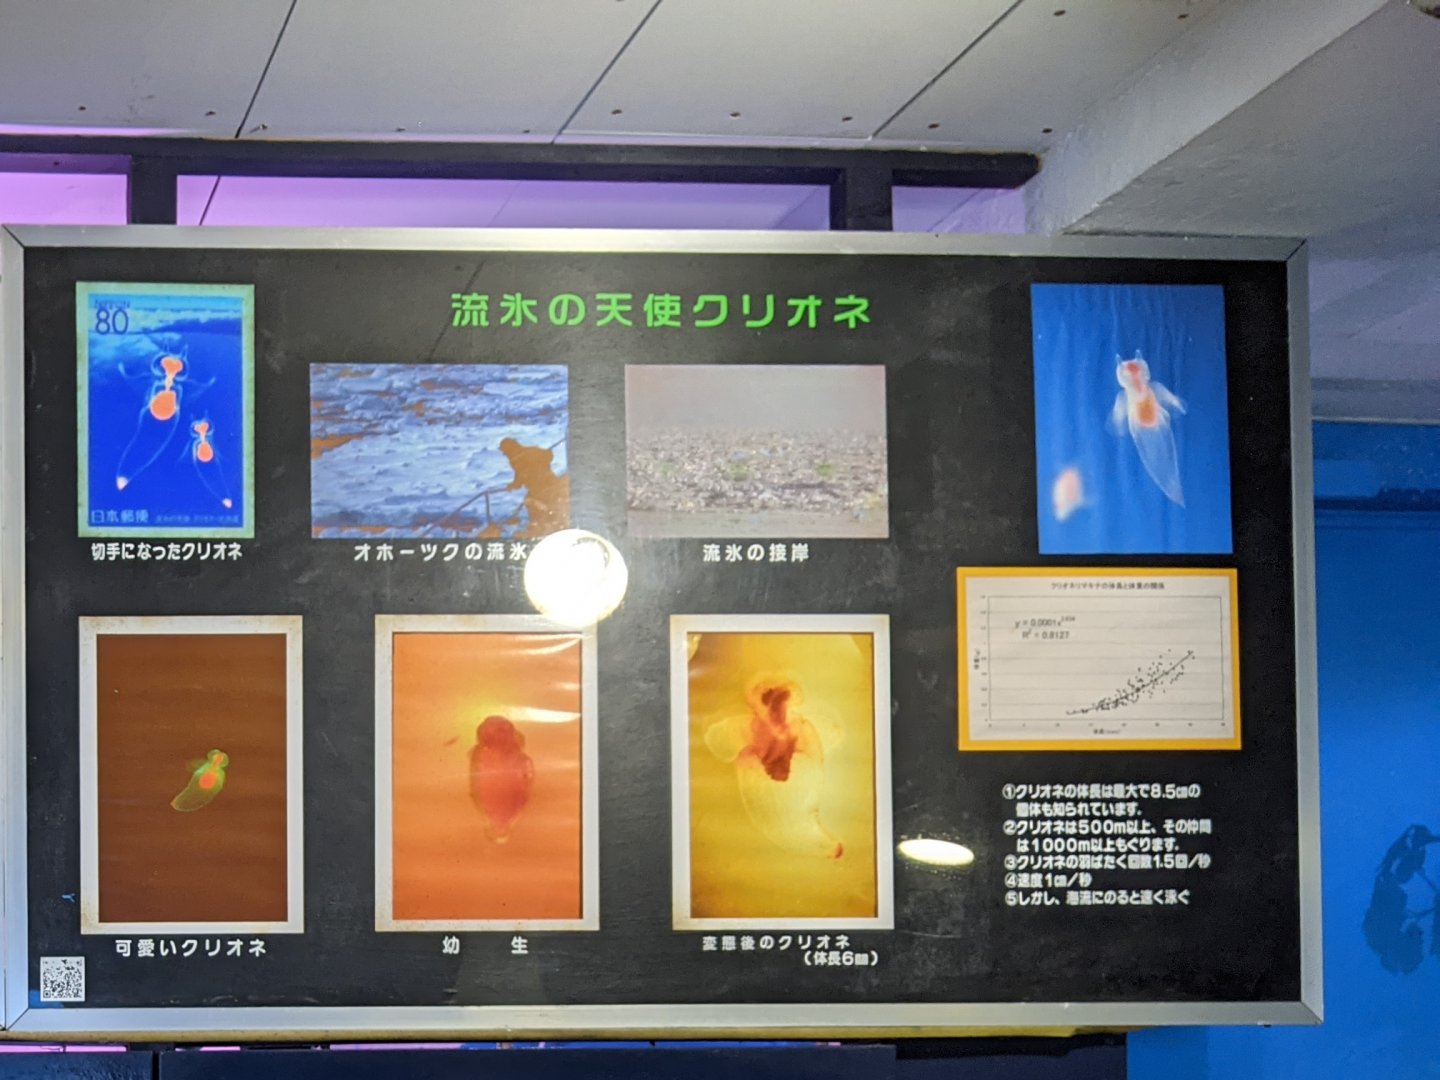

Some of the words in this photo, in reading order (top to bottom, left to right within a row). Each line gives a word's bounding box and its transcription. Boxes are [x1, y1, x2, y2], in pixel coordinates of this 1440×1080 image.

[450, 292, 872, 329] 流氷の天使クリオネ
[95, 309, 129, 335] 80
[91, 509, 149, 523] 日本郵便
[91, 542, 243, 561] 切手になったクリオネ
[703, 544, 810, 562] 流氷の接岸
[115, 939, 267, 957] 可愛いクリオネ
[702, 935, 851, 952] 変態後のクリオネ
